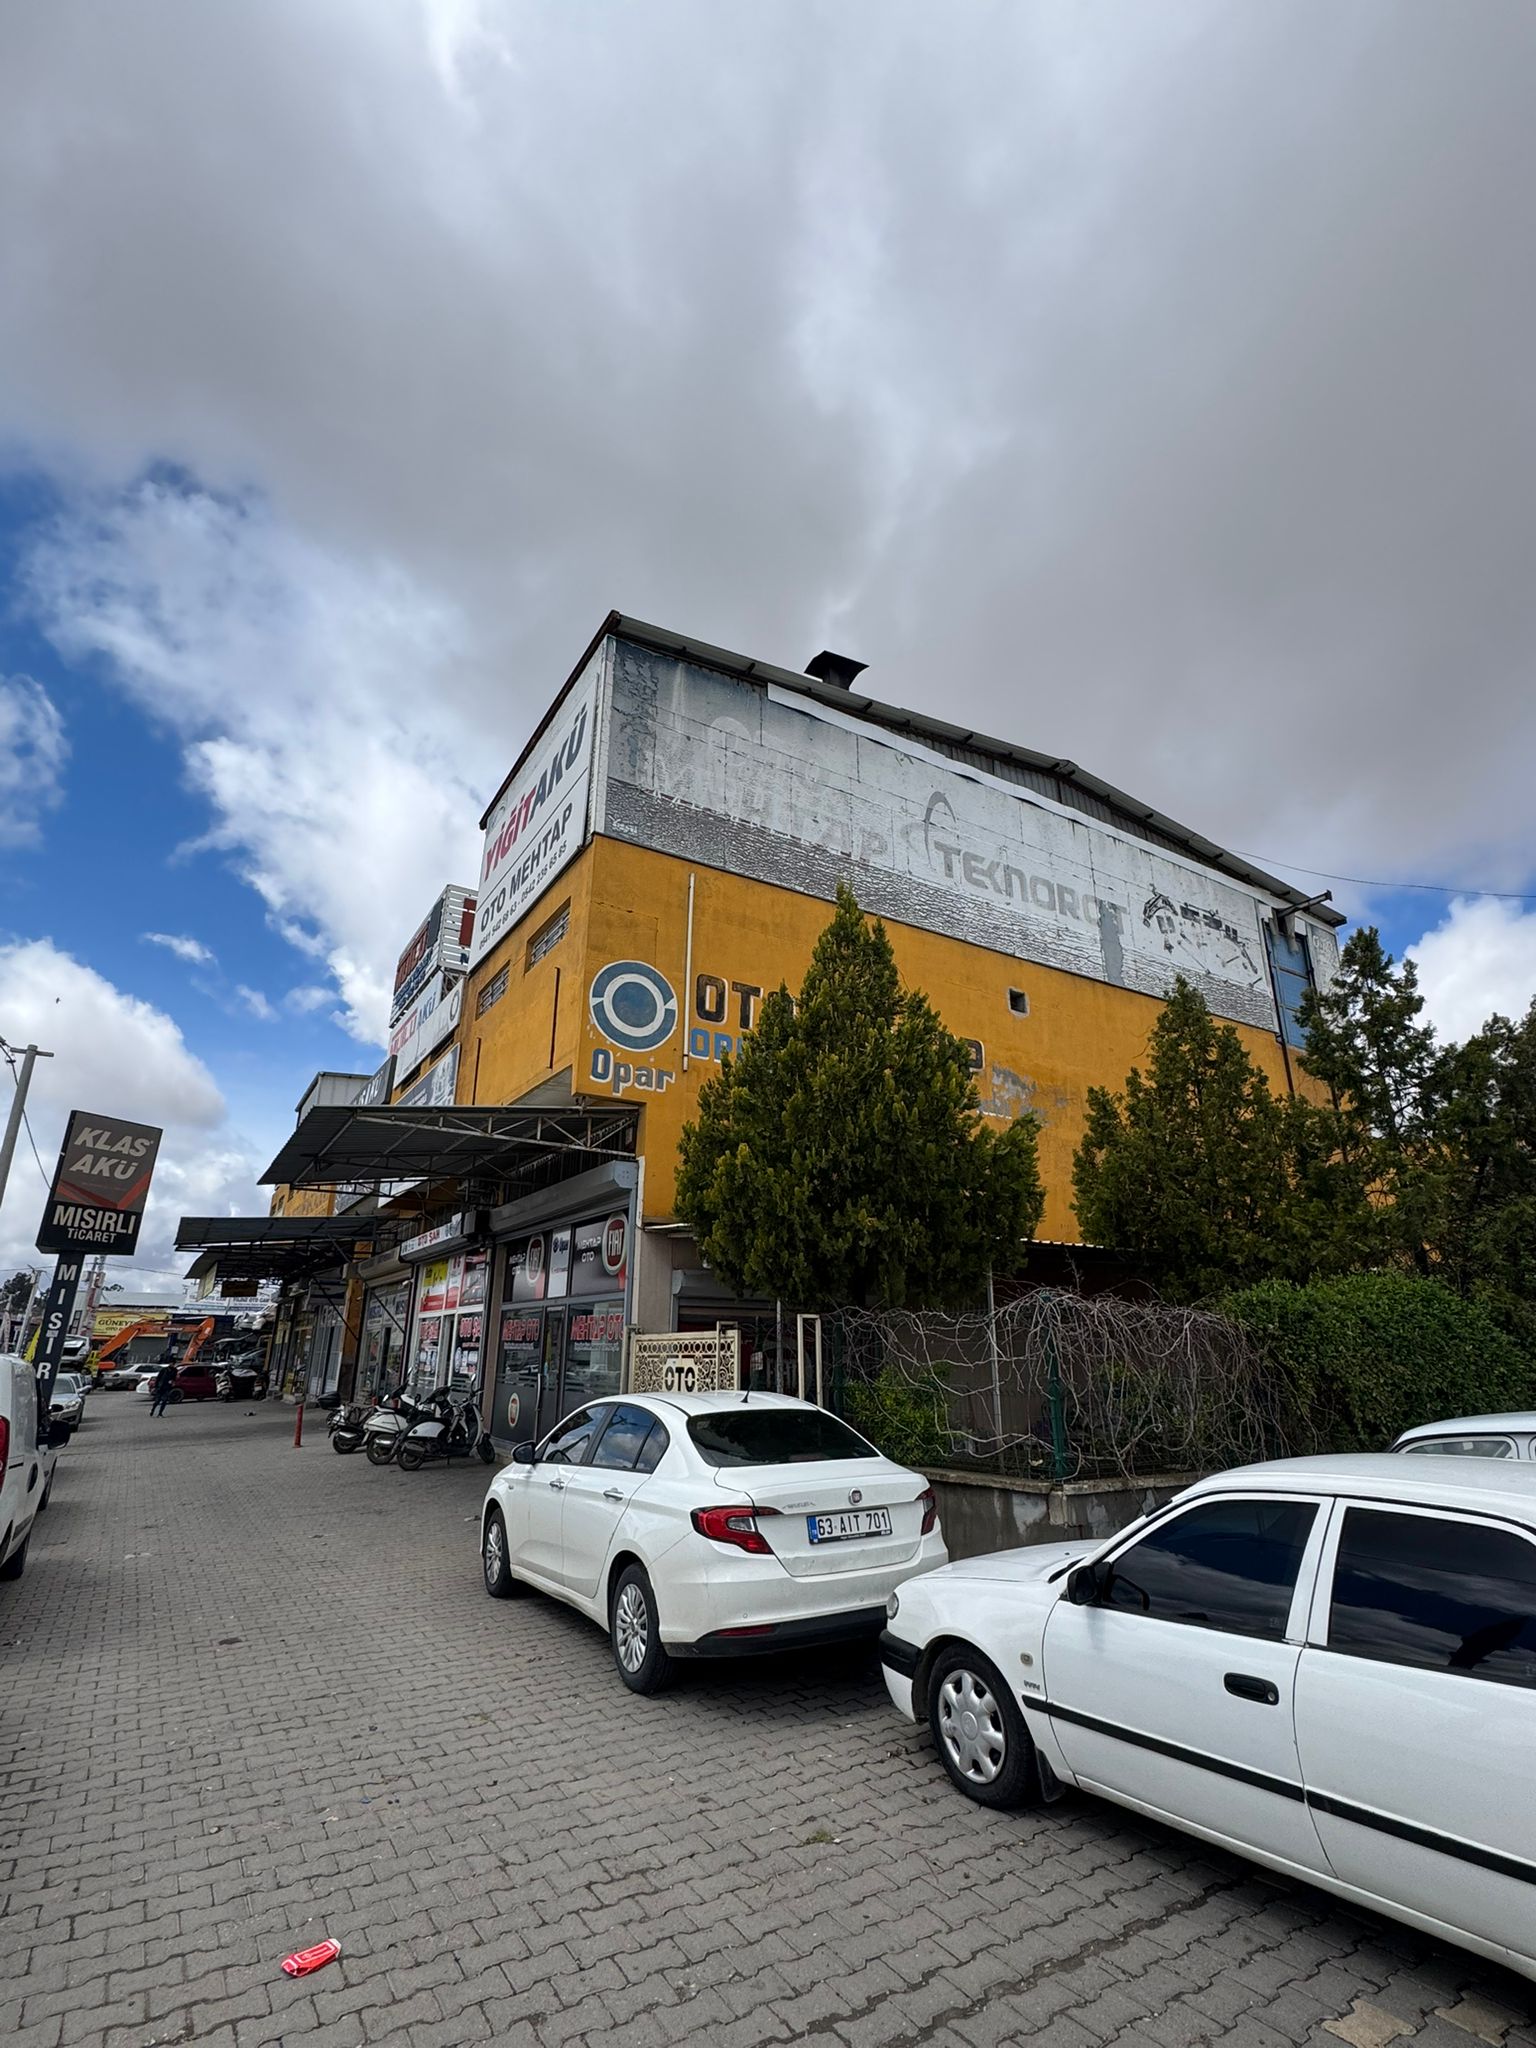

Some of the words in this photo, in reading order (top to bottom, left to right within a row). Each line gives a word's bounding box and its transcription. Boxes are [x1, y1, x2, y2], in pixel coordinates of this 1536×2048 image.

[481, 887, 507, 933] OTO
[509, 802, 573, 900] MEHTAP
[590, 1048, 675, 1096] Opar
[74, 1127, 151, 1157] KLAS
[69, 1153, 139, 1180] AKÜ
[52, 1205, 137, 1235] MISIRLI
[608, 1228, 624, 1256] FIAT
[581, 1251, 595, 1263] OTO
[664, 1366, 696, 1392] OTO
[817, 1518, 834, 1536] 63
[840, 1515, 860, 1534] AIT
[866, 1511, 888, 1531] 701
